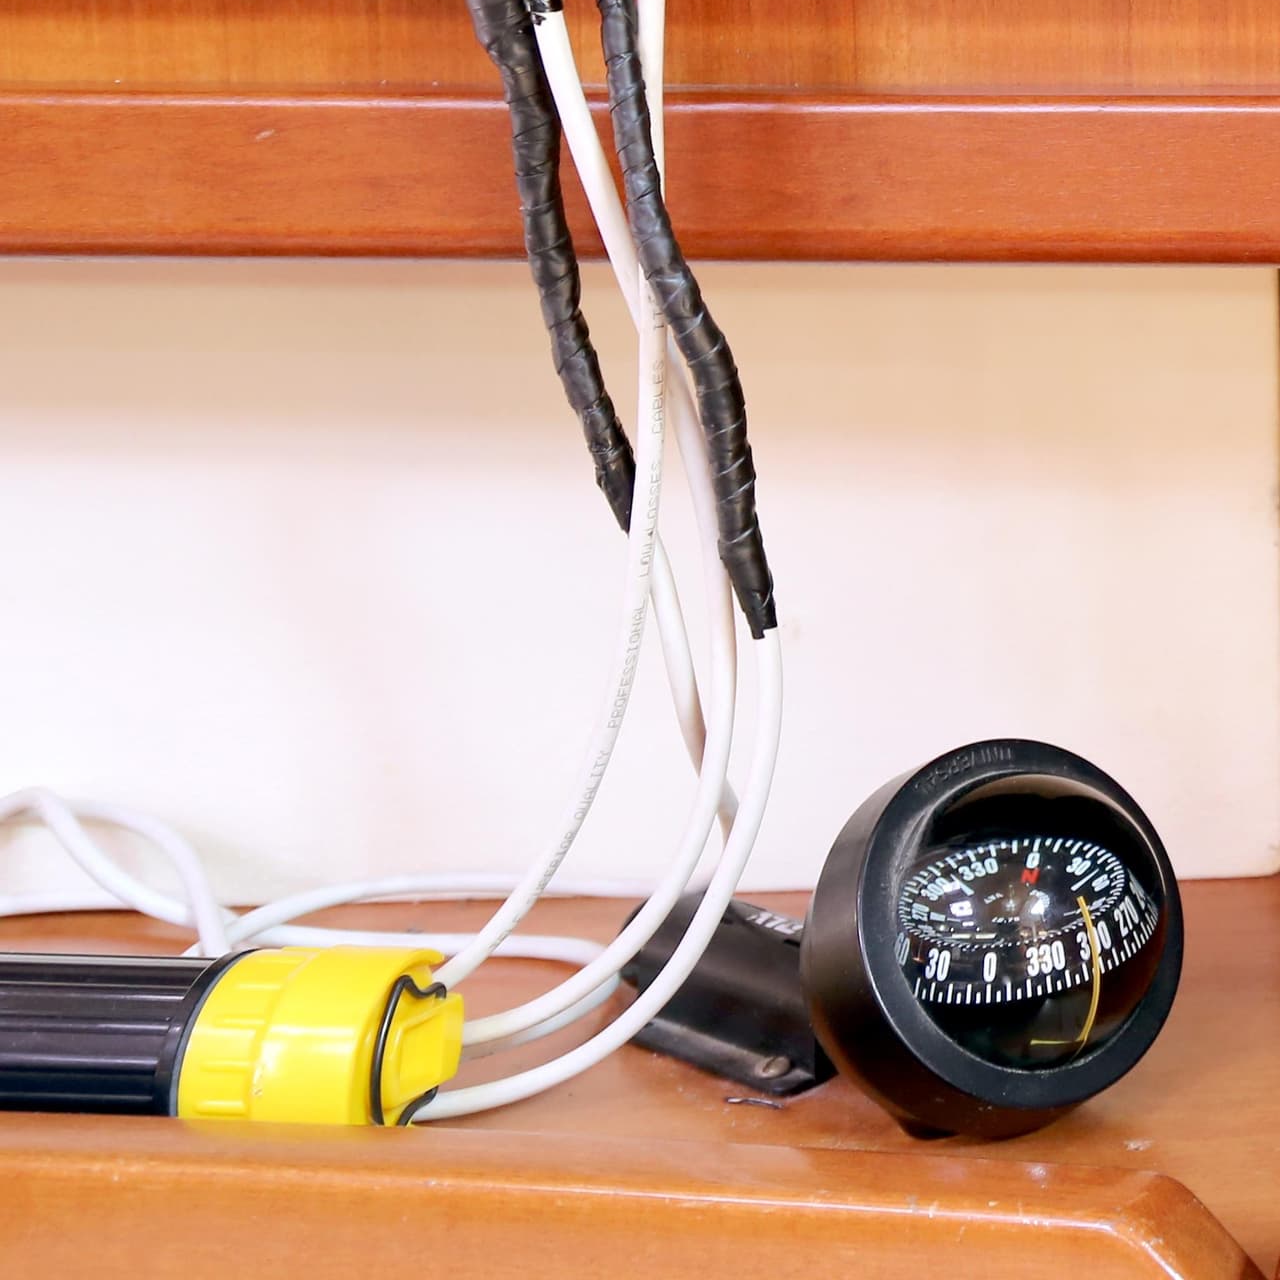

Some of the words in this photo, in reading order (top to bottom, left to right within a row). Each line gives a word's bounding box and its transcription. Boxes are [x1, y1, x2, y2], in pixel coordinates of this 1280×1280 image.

[651, 359, 665, 434] CABLES
[645, 463, 661, 532] LOSSES
[639, 543, 654, 578] LOW
[607, 598, 646, 729] PROFESSIONAL
[574, 749, 611, 821] QUALITY
[958, 857, 999, 881] 330
[1020, 868, 1040, 885] N
[1026, 852, 1040, 869] 0
[1065, 856, 1092, 876] 30
[925, 947, 951, 982] 30
[983, 951, 998, 983] 0
[1025, 940, 1067, 977] 330
[1113, 895, 1140, 938] 270
